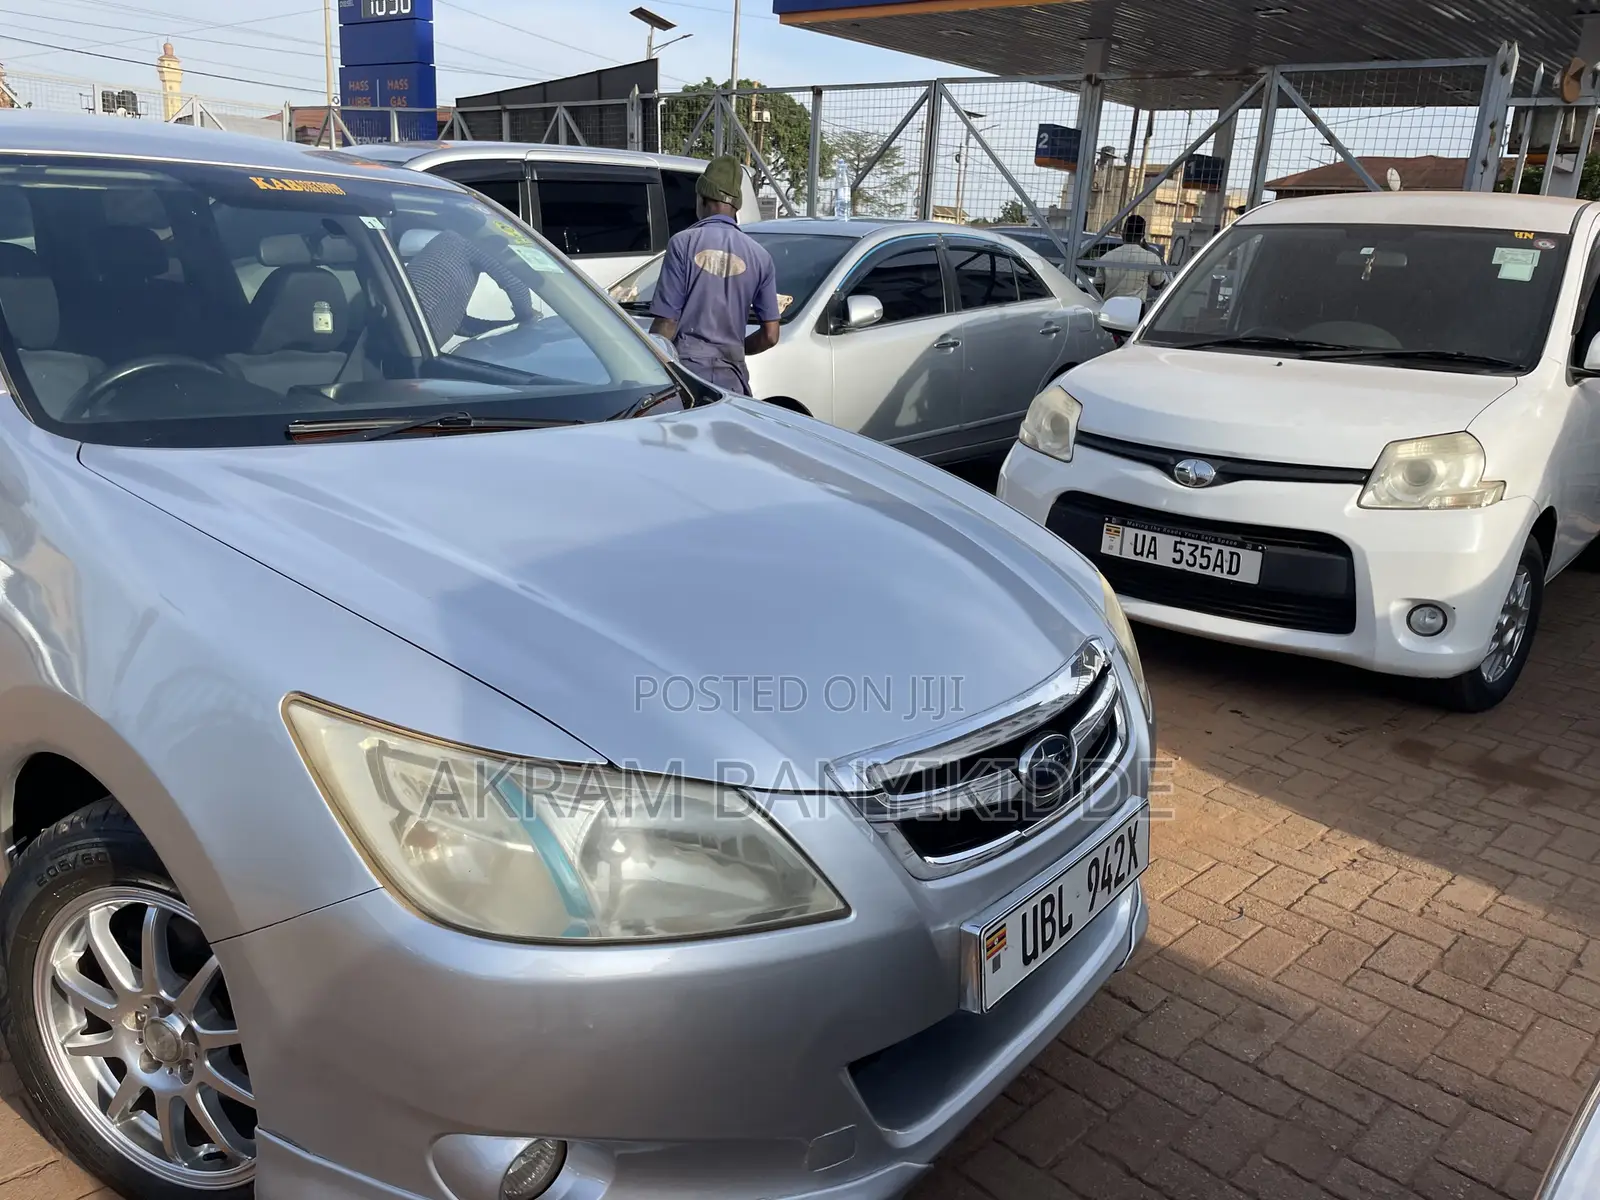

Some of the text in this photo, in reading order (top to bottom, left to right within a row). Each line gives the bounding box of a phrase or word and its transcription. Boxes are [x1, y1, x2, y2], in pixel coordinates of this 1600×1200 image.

[390, 96, 408, 107] GAS
[1038, 132, 1049, 149] 2
[1150, 524, 1162, 532] the
[1183, 530, 1199, 539] Your
[1133, 532, 1158, 561] UA
[1171, 539, 1242, 576] 535AD
[1021, 819, 1140, 967] UBL 942X
